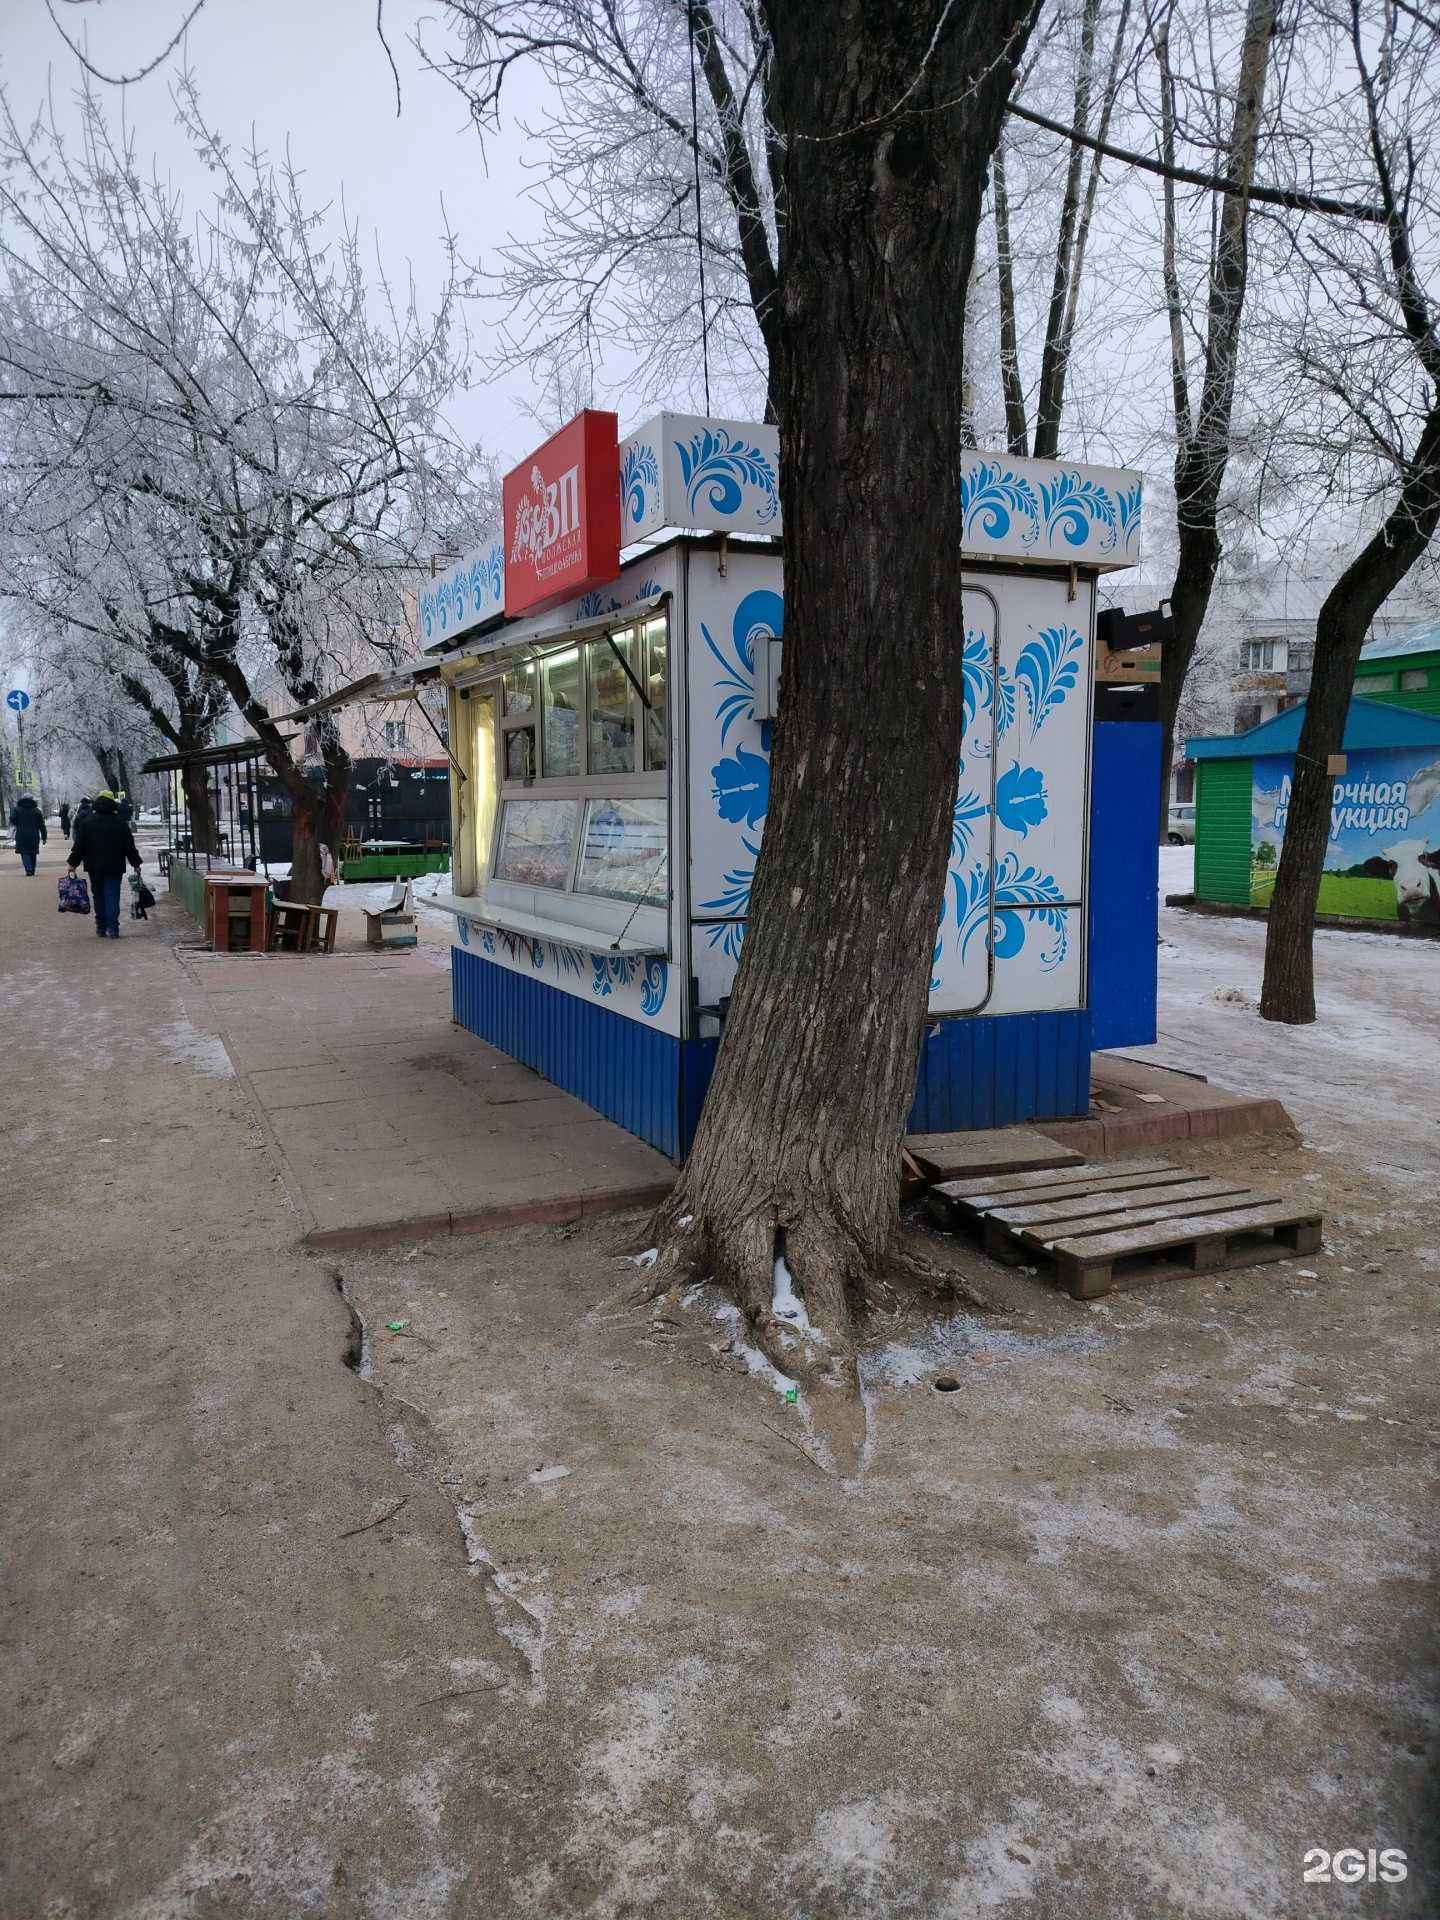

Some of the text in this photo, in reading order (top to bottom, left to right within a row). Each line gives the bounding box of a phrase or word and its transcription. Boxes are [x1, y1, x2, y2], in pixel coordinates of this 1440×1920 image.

[543, 465, 580, 548] ВП
[1280, 774, 1407, 805] Мочная
[1274, 806, 1409, 840] пукция
